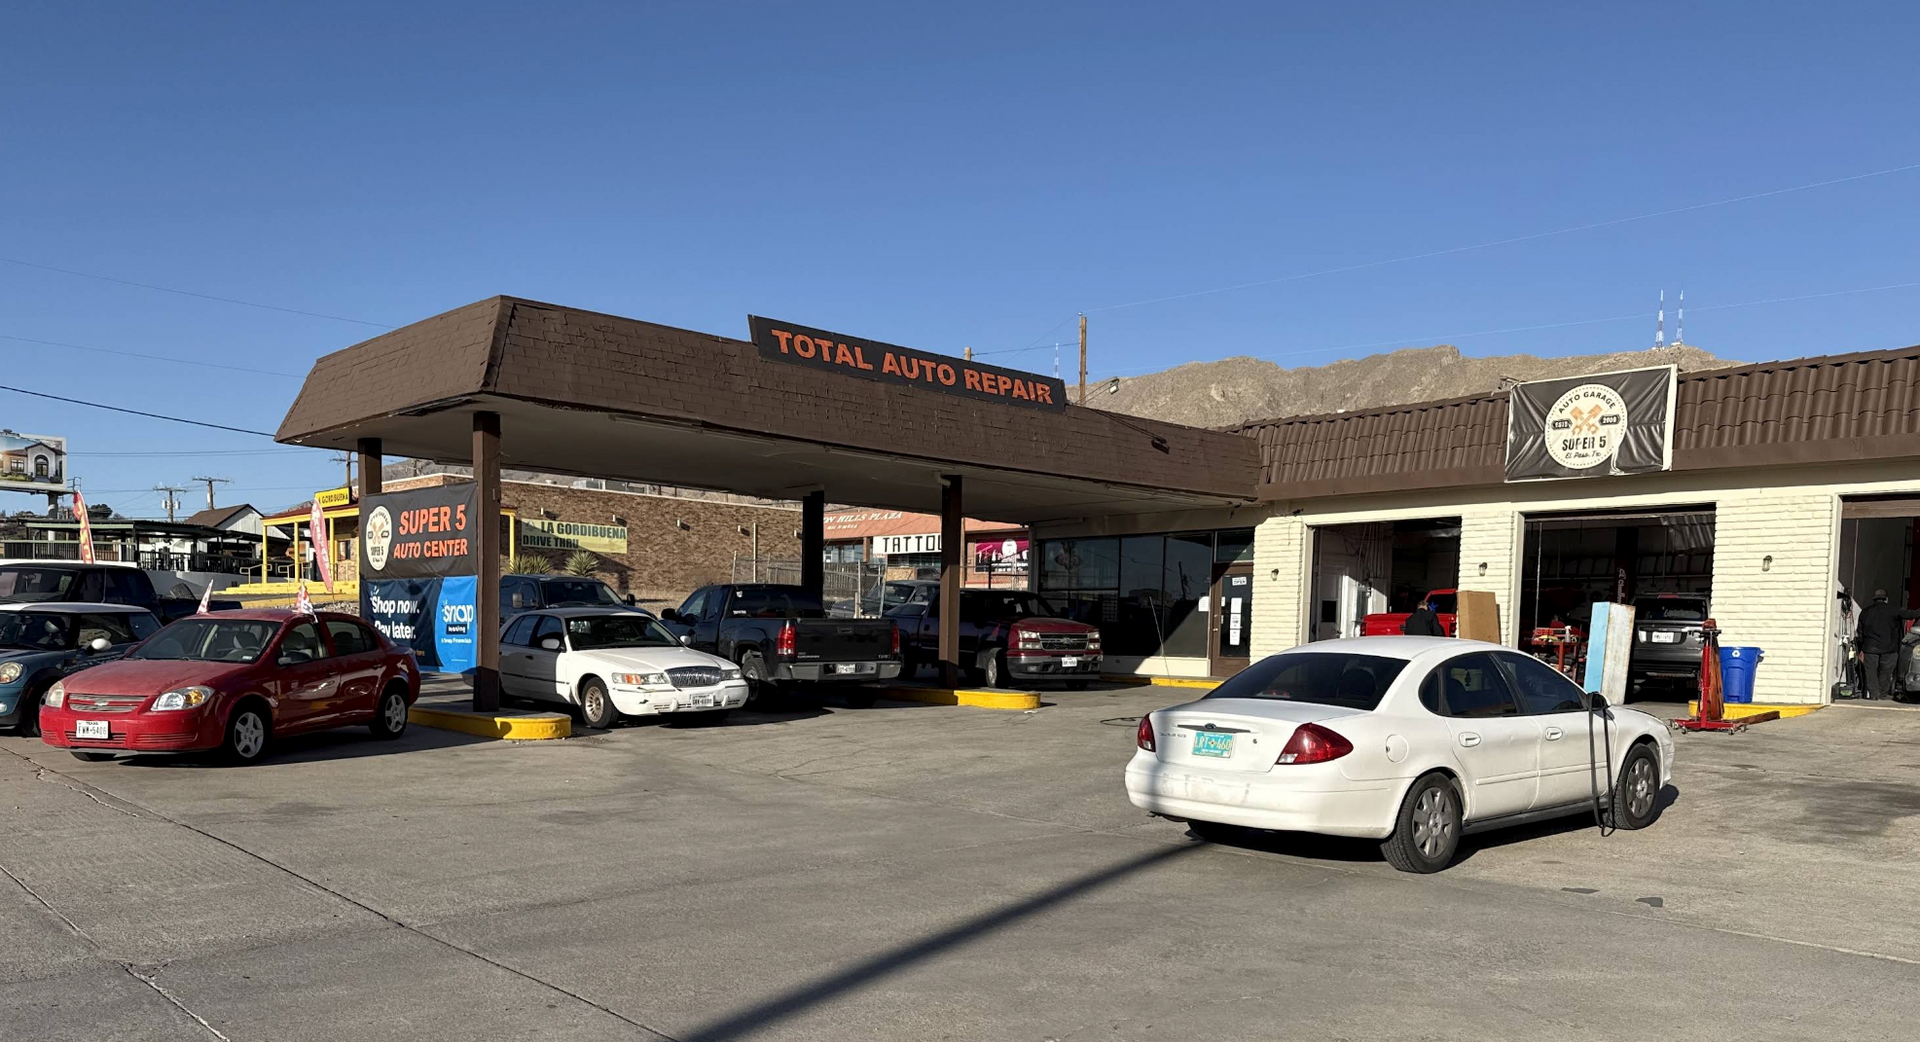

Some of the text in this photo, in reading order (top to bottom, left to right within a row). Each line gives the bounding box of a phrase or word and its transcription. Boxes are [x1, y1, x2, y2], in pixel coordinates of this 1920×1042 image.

[771, 329, 1053, 405] TOTAL AUTO REPAIR
[1558, 391, 1616, 414] AUTO GARAGE
[1562, 435, 1607, 451] SUPER 5
[398, 504, 466, 536] SUPER 5
[837, 514, 867, 523] HILLS
[870, 511, 903, 520] PLAZA
[541, 521, 626, 539] LA GORDIBUENA
[393, 538, 468, 559] AUTO CENTER
[523, 535, 579, 549] DRIVE THRU
[371, 596, 420, 618] Shop now.
[443, 604, 474, 630] snap
[374, 620, 416, 639] Pay later.
